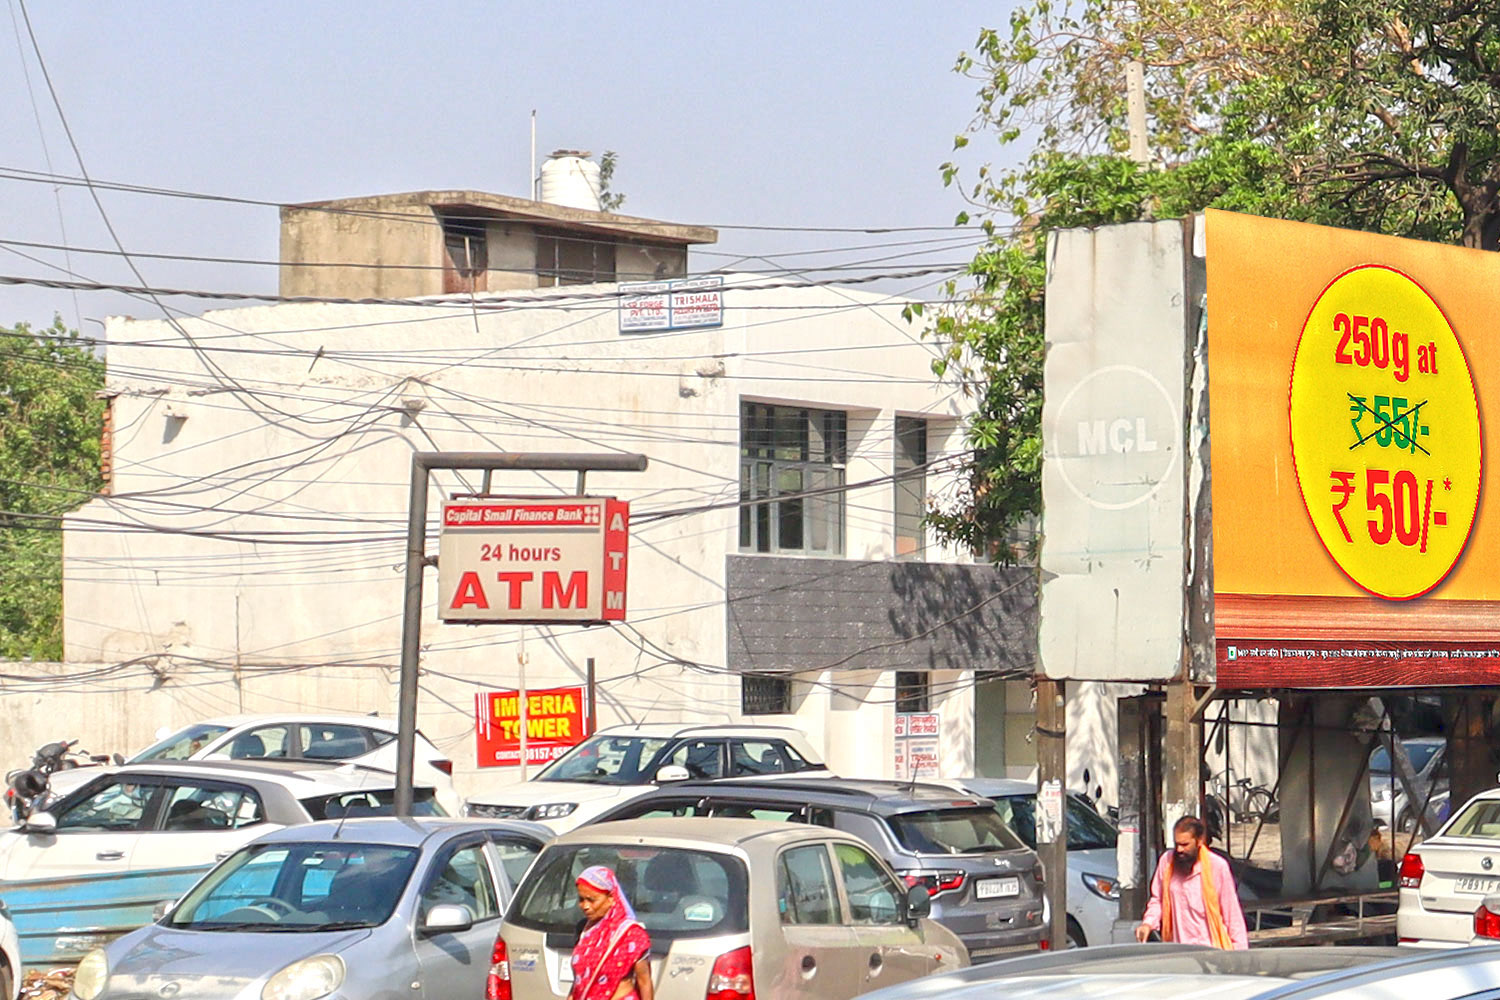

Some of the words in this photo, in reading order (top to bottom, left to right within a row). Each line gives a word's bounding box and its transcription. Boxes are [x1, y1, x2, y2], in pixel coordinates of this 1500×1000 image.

[674, 293, 718, 305] TRISHALA
[1334, 313, 1410, 382] 250g
[1418, 341, 1439, 375] at
[1077, 417, 1158, 455] MCL
[446, 508, 481, 524] Capital
[484, 508, 511, 521] Small
[514, 508, 554, 521] Finance
[556, 508, 583, 521] Bank
[480, 544, 502, 561] 24
[509, 544, 561, 561] hours
[450, 571, 588, 609] ATM
